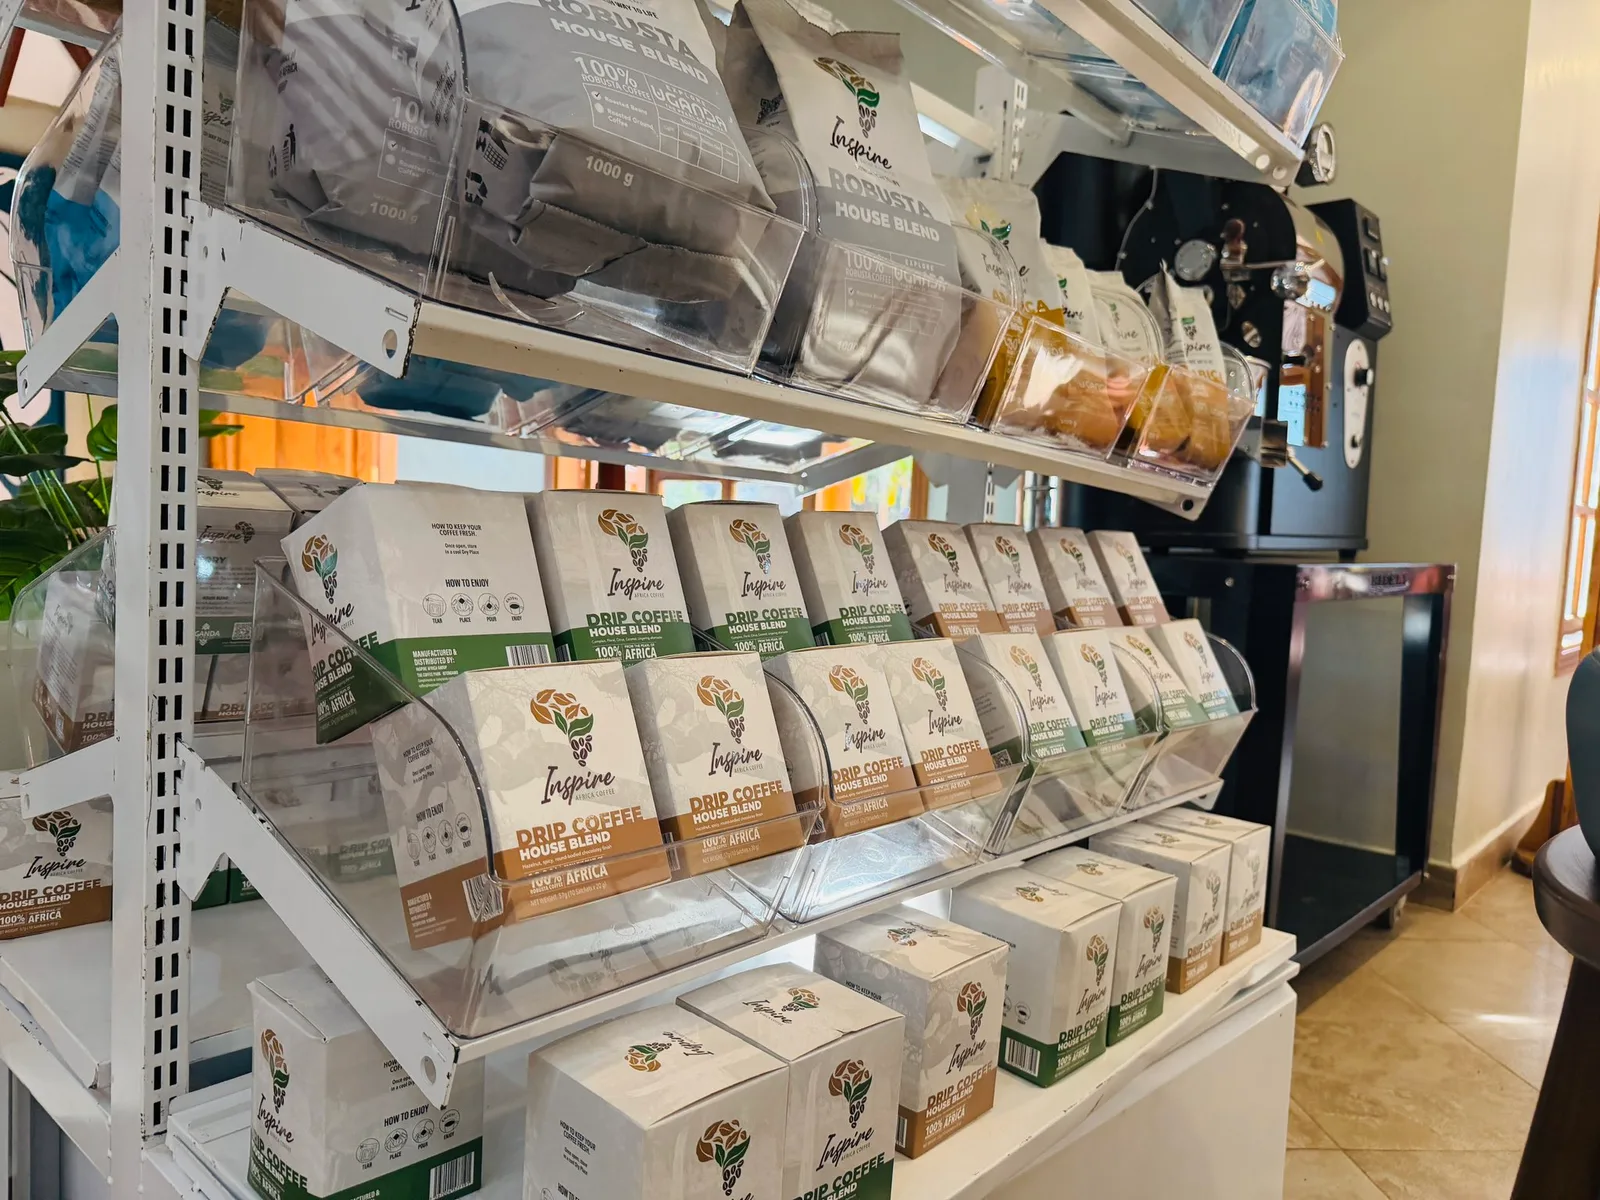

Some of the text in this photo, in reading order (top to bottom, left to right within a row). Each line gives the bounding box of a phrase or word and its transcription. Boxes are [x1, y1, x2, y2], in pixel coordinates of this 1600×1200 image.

[550, 18, 709, 84] HOUSE BLEND
[574, 56, 638, 88] 100%
[581, 74, 650, 99] ROBUSTA COFFEE
[606, 108, 631, 121] Roasted
[650, 84, 727, 132] UGANDA
[608, 116, 628, 128] Coffee
[830, 116, 892, 170] Inspire
[585, 155, 634, 187] 1000 g
[828, 167, 934, 220] ROBUSTA
[371, 201, 406, 220] 1000
[835, 201, 940, 242] HOUSE BLEND
[199, 524, 242, 542] Inspire
[445, 579, 489, 587] HOW TO ENJOY
[607, 568, 664, 600] Inspire
[741, 571, 787, 600] Inspire
[852, 571, 888, 596] Inspire
[944, 574, 972, 595] Inspire
[726, 607, 803, 624] DRIP COFFEE
[839, 606, 867, 618] DRIP
[939, 602, 988, 612] DRIP COFFEE
[1002, 602, 1045, 613] DRIP COFFEE
[586, 610, 683, 626] DRIP COFFEE
[729, 621, 787, 634] HOUSE BLEND
[842, 615, 891, 626] HOUSE BLEND
[589, 624, 661, 637] HOUSE BLEND
[848, 632, 890, 643] 100% AFRICA
[412, 649, 452, 658] MANUFACTURED
[596, 645, 657, 660] 100% AFRICA
[735, 640, 784, 653] 100% AFRICA
[328, 662, 352, 683] BLEND
[414, 658, 447, 666] DISTRIBUTED
[331, 689, 355, 713] AFRICA
[1028, 689, 1055, 712] Inspire
[928, 709, 962, 736] Inspire
[1089, 717, 1107, 729] DRIP
[844, 723, 885, 753] Inspire
[708, 742, 762, 777] Inspire
[920, 740, 981, 762] DRIP COFFEE
[832, 756, 904, 782] DRIP COFFEE
[924, 755, 967, 772] HOUSE BLEND
[541, 766, 615, 805] Inspire
[834, 774, 888, 793] HOUSE BLEND
[575, 788, 615, 801] AFRICA COFFEE
[689, 780, 784, 813] DRIP COFFEE
[864, 797, 888, 813] AFRICA
[416, 802, 444, 822] HOW TO ENJOY
[693, 800, 762, 824] HOUSE BLEND
[516, 806, 643, 847] DRIP COFFEE
[730, 827, 760, 846] AFRICA
[520, 831, 611, 861] HOUSE BLEND
[23, 856, 86, 879] Inspire
[522, 861, 542, 869] Hazelnut,
[566, 863, 608, 885] AFRICA
[0, 879, 101, 901] DRIP COFFEE
[0, 894, 71, 910] HOUSE BLEND
[0, 911, 62, 924] 100% AFRICA
[846, 980, 854, 989] HOW
[1121, 988, 1140, 1005] DRIP
[742, 1000, 792, 1023] Inspire
[1059, 1023, 1082, 1041] DRIP
[1058, 1038, 1080, 1051] HOUSE
[1072, 1044, 1090, 1061] AFRICA
[946, 1039, 987, 1075] Inspire
[928, 1060, 993, 1108] DRIP COFFEE
[926, 1085, 974, 1118] HOUSE BLEND
[257, 1093, 294, 1143] Inspire
[384, 1104, 430, 1127] HOW TO ENJOY
[926, 1106, 965, 1135] 100% AFRICA
[560, 1119, 596, 1151] HOW TO KEEP YOUR
[563, 1131, 577, 1146] COFFEE
[390, 1152, 401, 1160] PLACE
[444, 1132, 454, 1140] ENJOY
[816, 1127, 874, 1172] Inspire
[841, 1143, 871, 1160] AFRICA COFFEE
[267, 1148, 307, 1192] COFFEE
[833, 1152, 885, 1191] COFFEE
[558, 1182, 568, 1196] HOW
